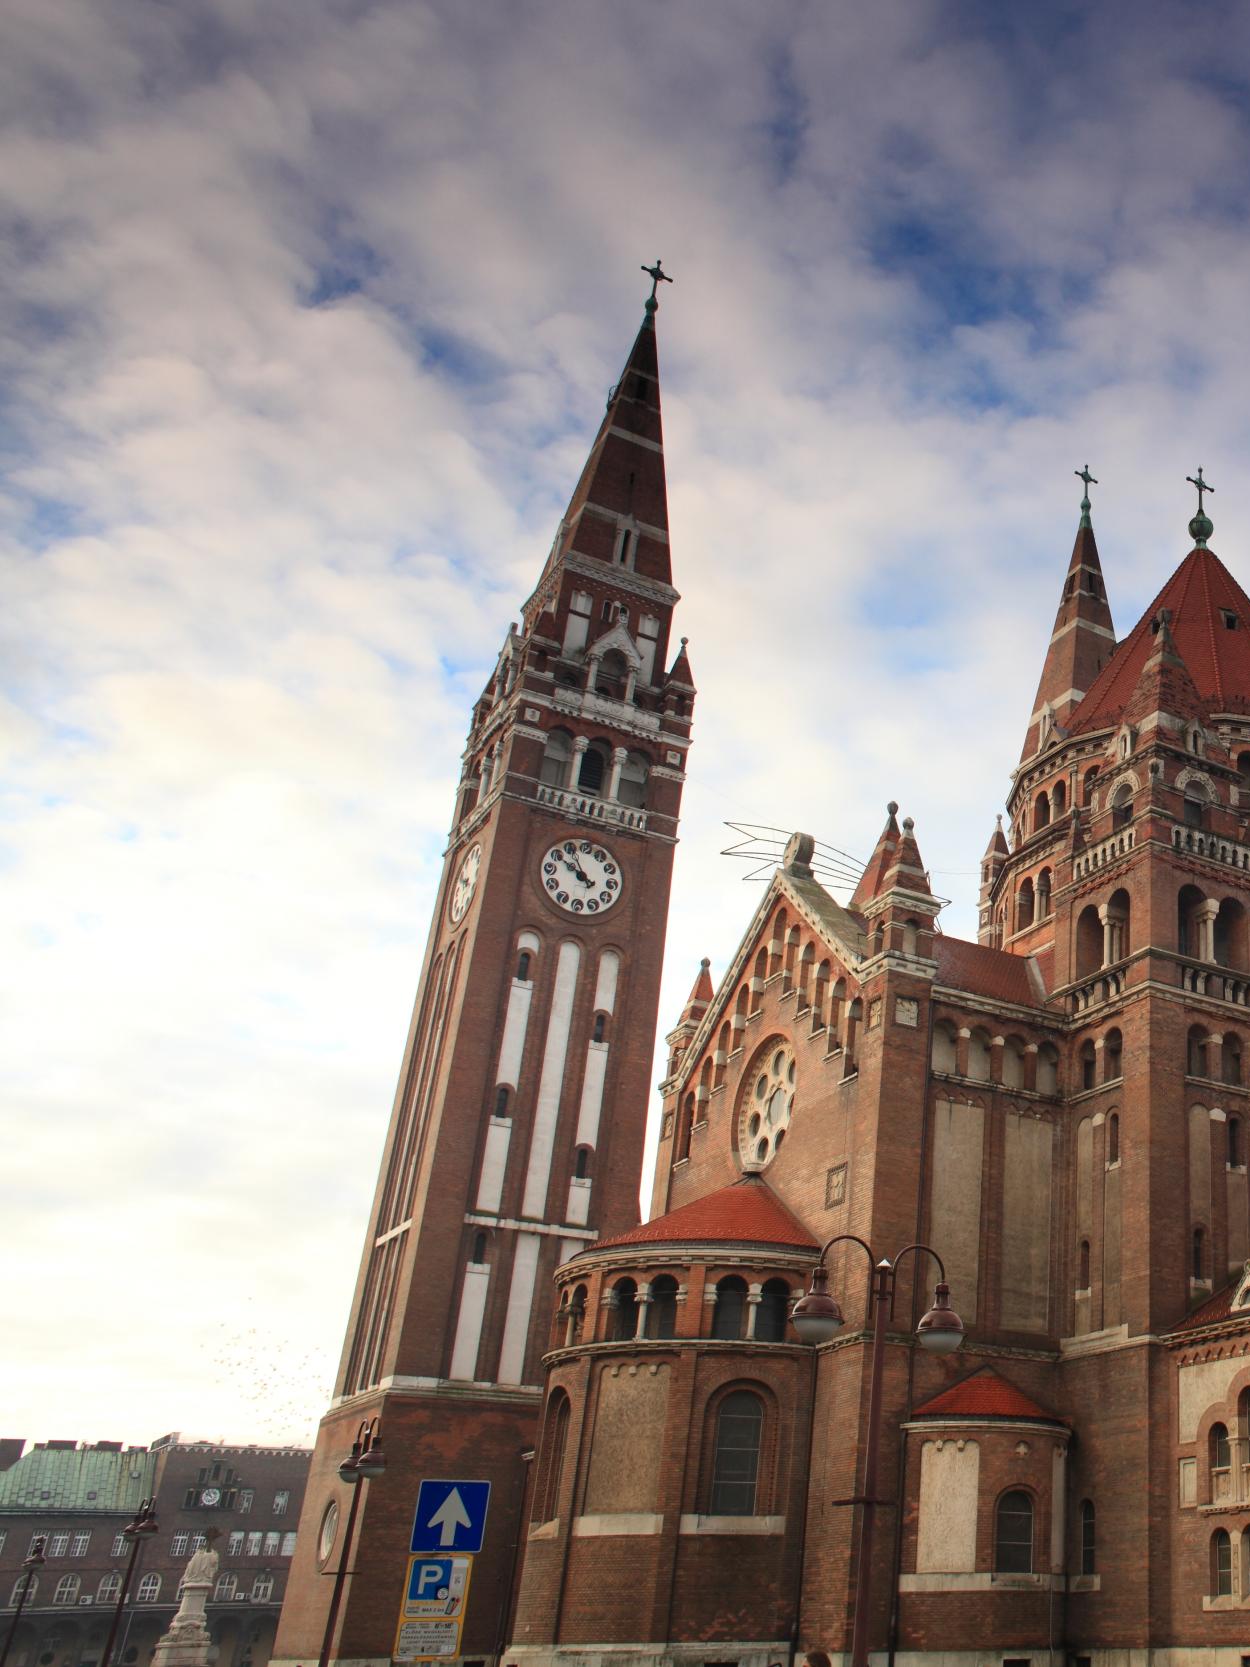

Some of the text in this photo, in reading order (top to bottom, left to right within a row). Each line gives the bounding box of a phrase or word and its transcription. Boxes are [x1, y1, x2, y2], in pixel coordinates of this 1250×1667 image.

[582, 843, 590, 853] 12
[547, 864, 555, 874] 9
[607, 865, 614, 874] 2
[559, 893, 566, 903] 7
[602, 893, 610, 903] 4
[573, 900, 582, 911] 6
[589, 900, 596, 911] 5
[418, 1565, 443, 1594] P
